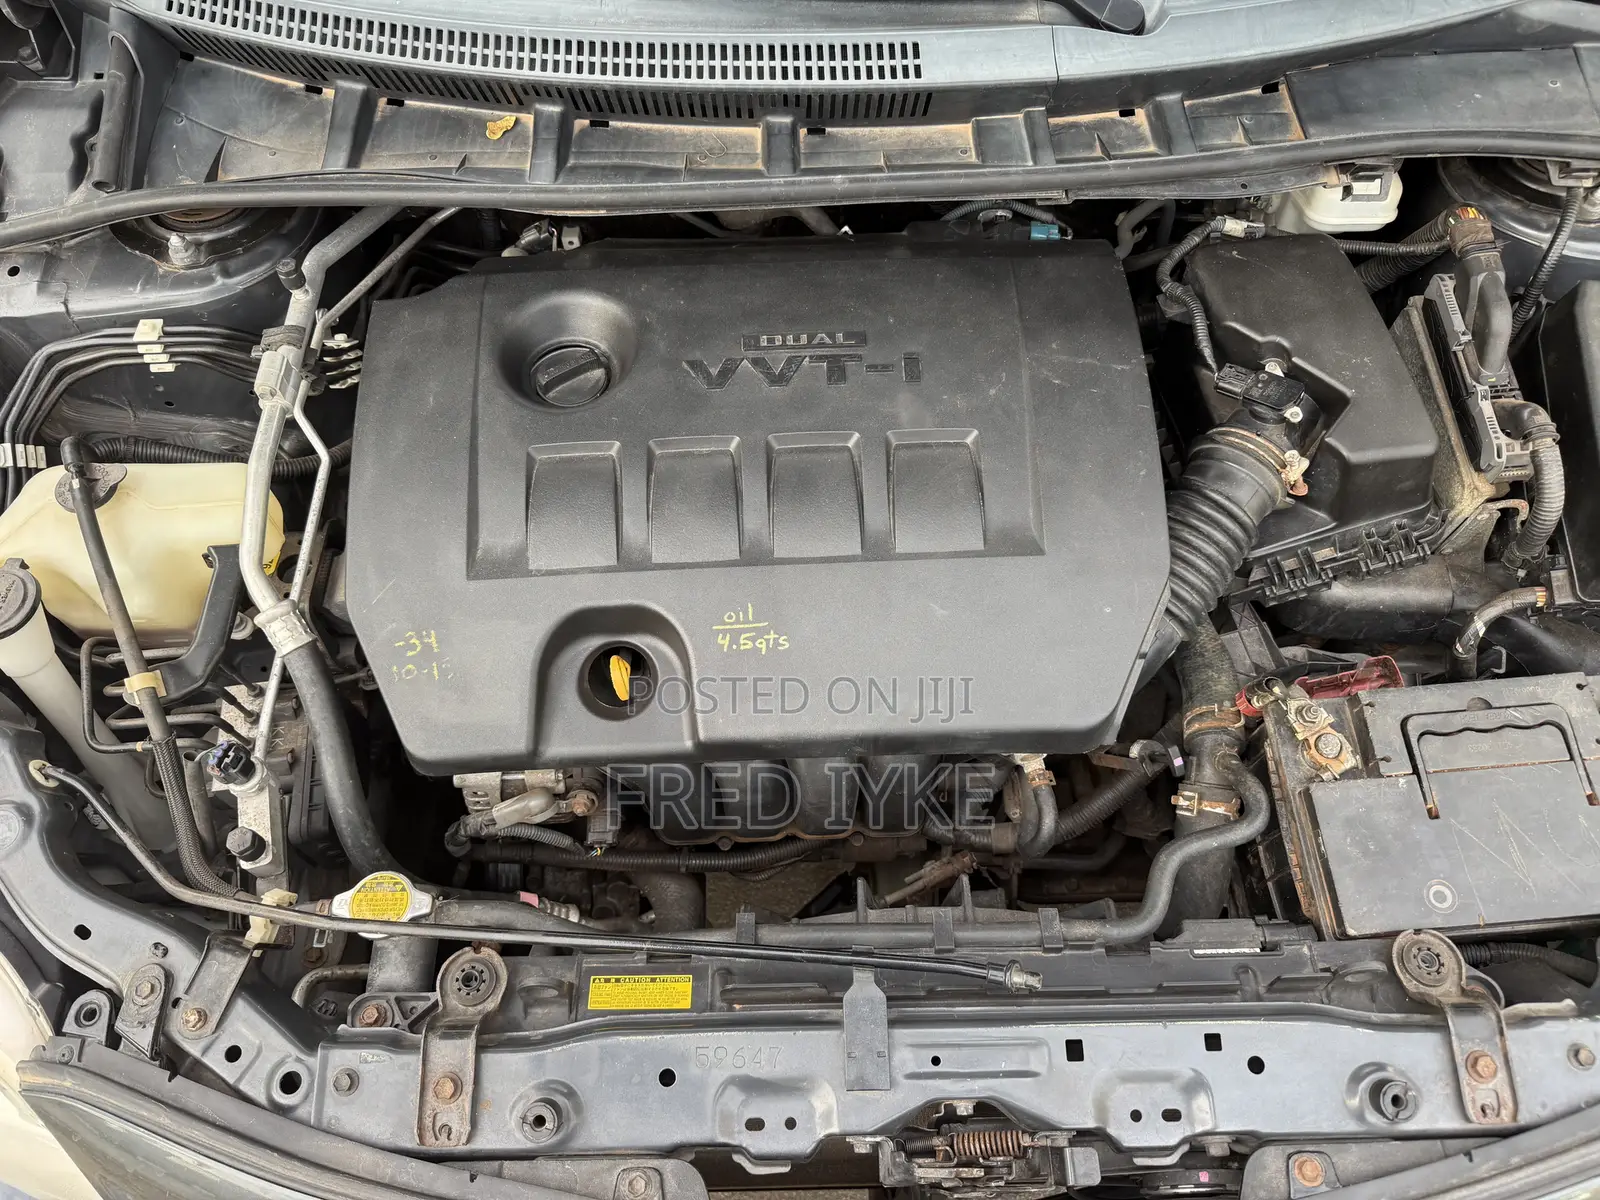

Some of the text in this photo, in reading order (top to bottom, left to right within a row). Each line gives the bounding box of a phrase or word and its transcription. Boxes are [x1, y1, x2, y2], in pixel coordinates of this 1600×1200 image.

[759, 333, 856, 347] DUAL
[723, 602, 754, 622] oil
[695, 1046, 783, 1069] 59647
